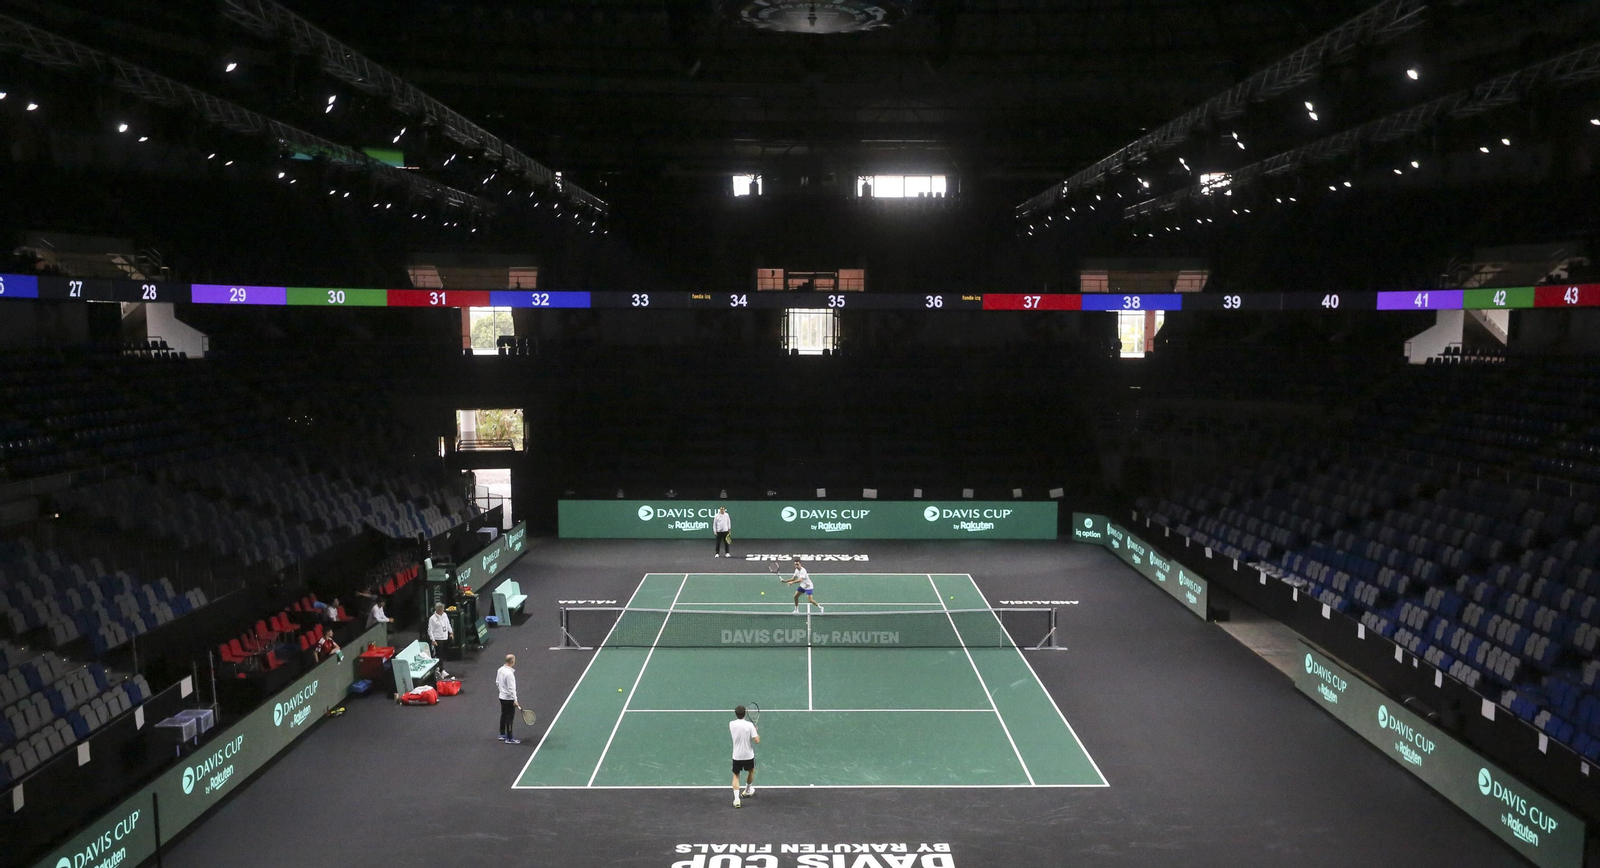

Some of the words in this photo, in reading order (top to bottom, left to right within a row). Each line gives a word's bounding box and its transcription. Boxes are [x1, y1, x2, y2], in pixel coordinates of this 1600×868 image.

[69, 281, 83, 297] 27
[142, 285, 157, 300] 28
[229, 288, 247, 303] 29
[1563, 287, 1579, 303] 43
[328, 290, 345, 304] 30
[429, 292, 446, 305] 31
[531, 293, 549, 306] 32
[631, 294, 649, 307] 33
[730, 294, 748, 307] 34
[827, 295, 845, 308] 35
[925, 295, 943, 308] 36
[1023, 296, 1041, 309] 37
[1122, 296, 1140, 309] 38
[1223, 296, 1241, 309] 39
[1321, 295, 1339, 309] 40
[1413, 293, 1429, 308] 41
[1493, 290, 1506, 305] 42
[657, 508, 694, 518] DAVIS
[698, 508, 720, 518] CU
[800, 509, 838, 519] DAVIS
[841, 509, 869, 519] CUP
[942, 509, 980, 519] DAVIS
[983, 509, 1011, 519] CUP
[675, 520, 709, 531] Rakuten
[818, 521, 852, 531] Rakuten
[960, 521, 994, 531] Rakuten
[1082, 530, 1101, 538] option
[721, 629, 770, 644] DAVIS
[773, 629, 806, 644] CUP
[812, 631, 829, 645] by
[831, 631, 899, 644] RAKUTEN
[1313, 661, 1331, 684] DAVIS
[1332, 674, 1347, 692] CUP
[283, 690, 304, 716] DAVIS
[304, 679, 318, 700] CUP
[1320, 683, 1338, 704] Rakuten
[293, 705, 311, 725] Rakuten
[1389, 715, 1413, 742] DAVIS
[1415, 733, 1434, 755] CUP
[196, 749, 223, 781] DAVIS
[224, 735, 243, 759] CUP
[1399, 741, 1422, 766] Rakuten
[210, 764, 234, 790] Rakuten
[1493, 781, 1527, 816] DAVIS
[1529, 806, 1556, 834] CUP
[1501, 813, 1507, 824] by
[1507, 812, 1538, 847] Rakuten
[74, 831, 112, 868] DAVIS
[114, 811, 139, 841] CUP
[675, 843, 773, 853] FINALS
[781, 843, 907, 853] RAKUTEN
[917, 842, 951, 852] BY
[671, 853, 779, 868] CUP
[797, 853, 956, 868] DAVIS
